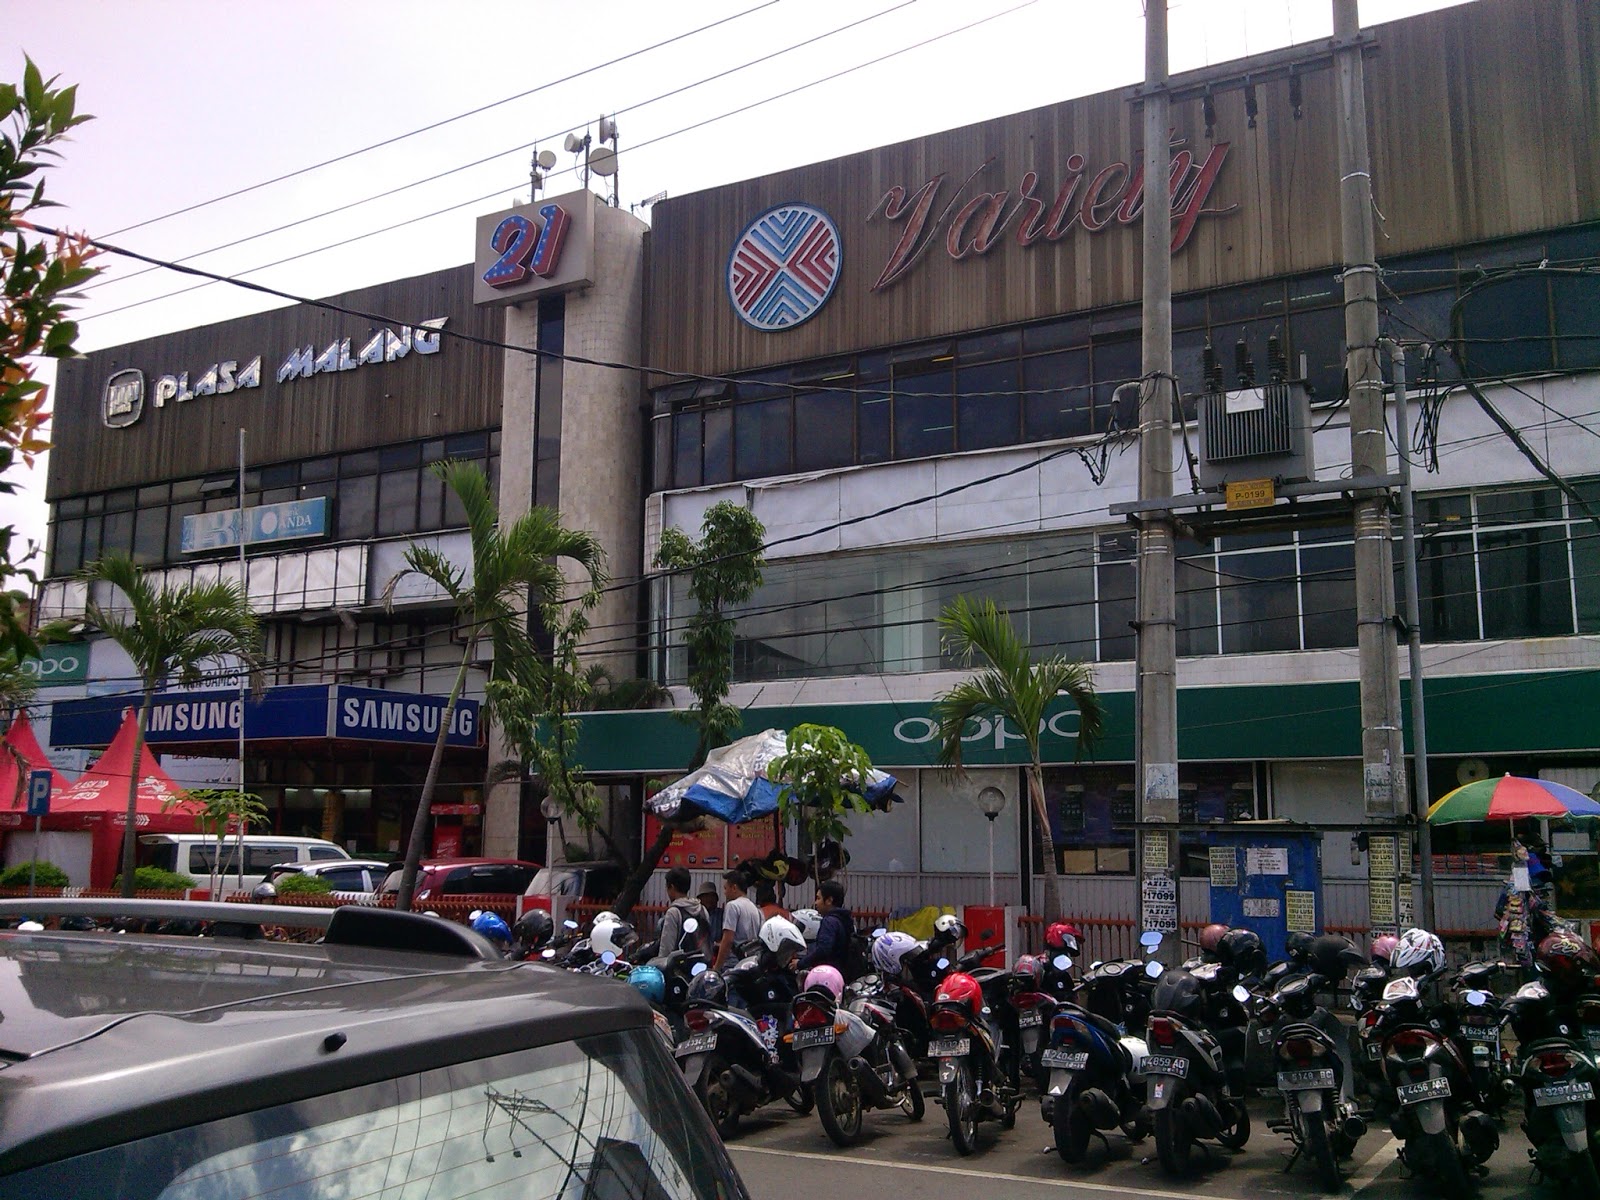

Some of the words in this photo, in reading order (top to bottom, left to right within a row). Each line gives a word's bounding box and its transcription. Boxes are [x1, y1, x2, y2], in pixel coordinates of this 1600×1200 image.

[866, 130, 1238, 293] Variety
[482, 203, 568, 288] 21
[152, 355, 262, 408] PLASA
[276, 317, 449, 384] MALANG
[1235, 490, 1265, 500] P-0199
[343, 697, 473, 736] SAMSUNG
[33, 777, 49, 809] P
[1143, 891, 1175, 901] 717099
[1144, 920, 1176, 928] 717099
[1141, 1058, 1147, 1068] N
[1147, 1057, 1170, 1067] 4859
[1398, 1087, 1405, 1097] N
[1408, 1083, 1429, 1094] 4456
[1545, 1085, 1570, 1097] 3297
